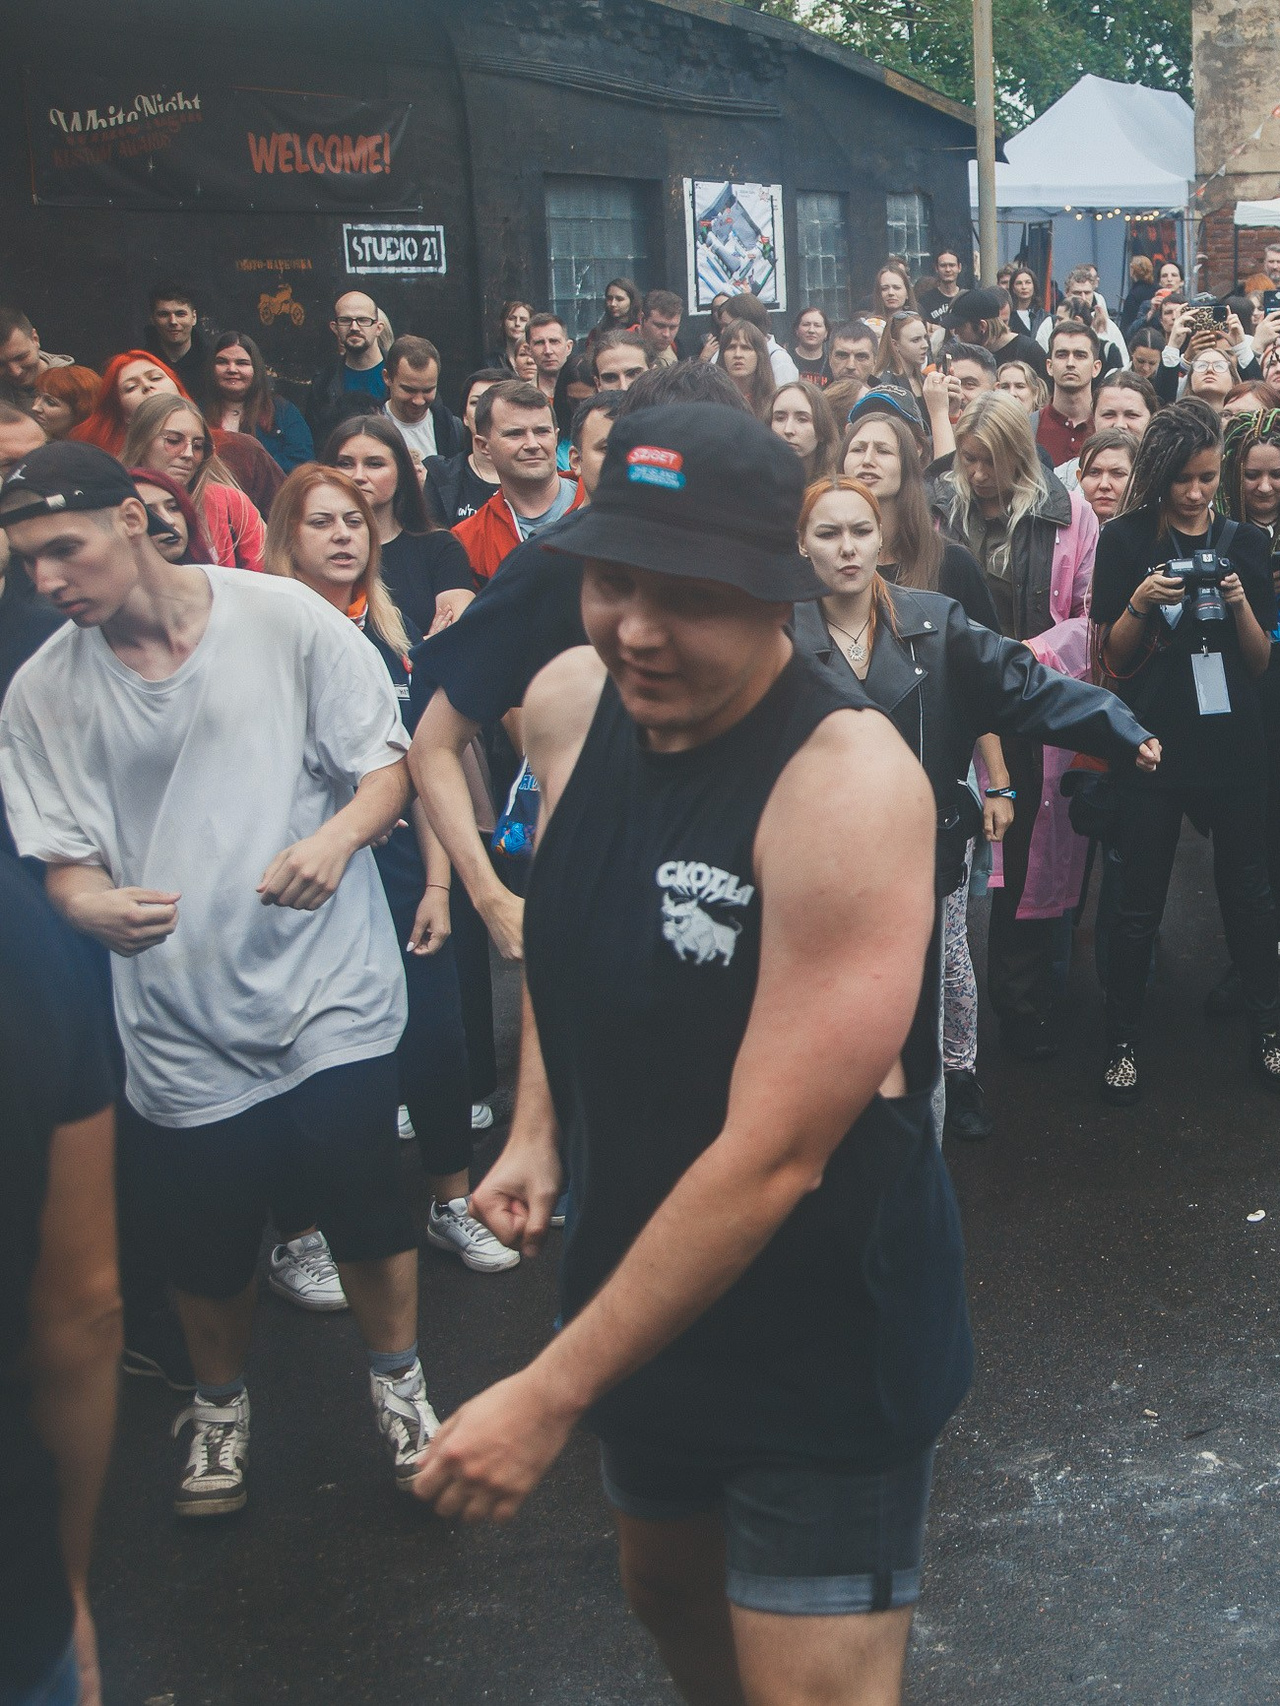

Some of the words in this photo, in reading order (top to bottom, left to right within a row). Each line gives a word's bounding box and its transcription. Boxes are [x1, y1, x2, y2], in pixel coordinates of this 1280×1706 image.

[248, 131, 392, 175] WELCOME!
[352, 236, 419, 263] STUDIO
[422, 237, 439, 262] 21
